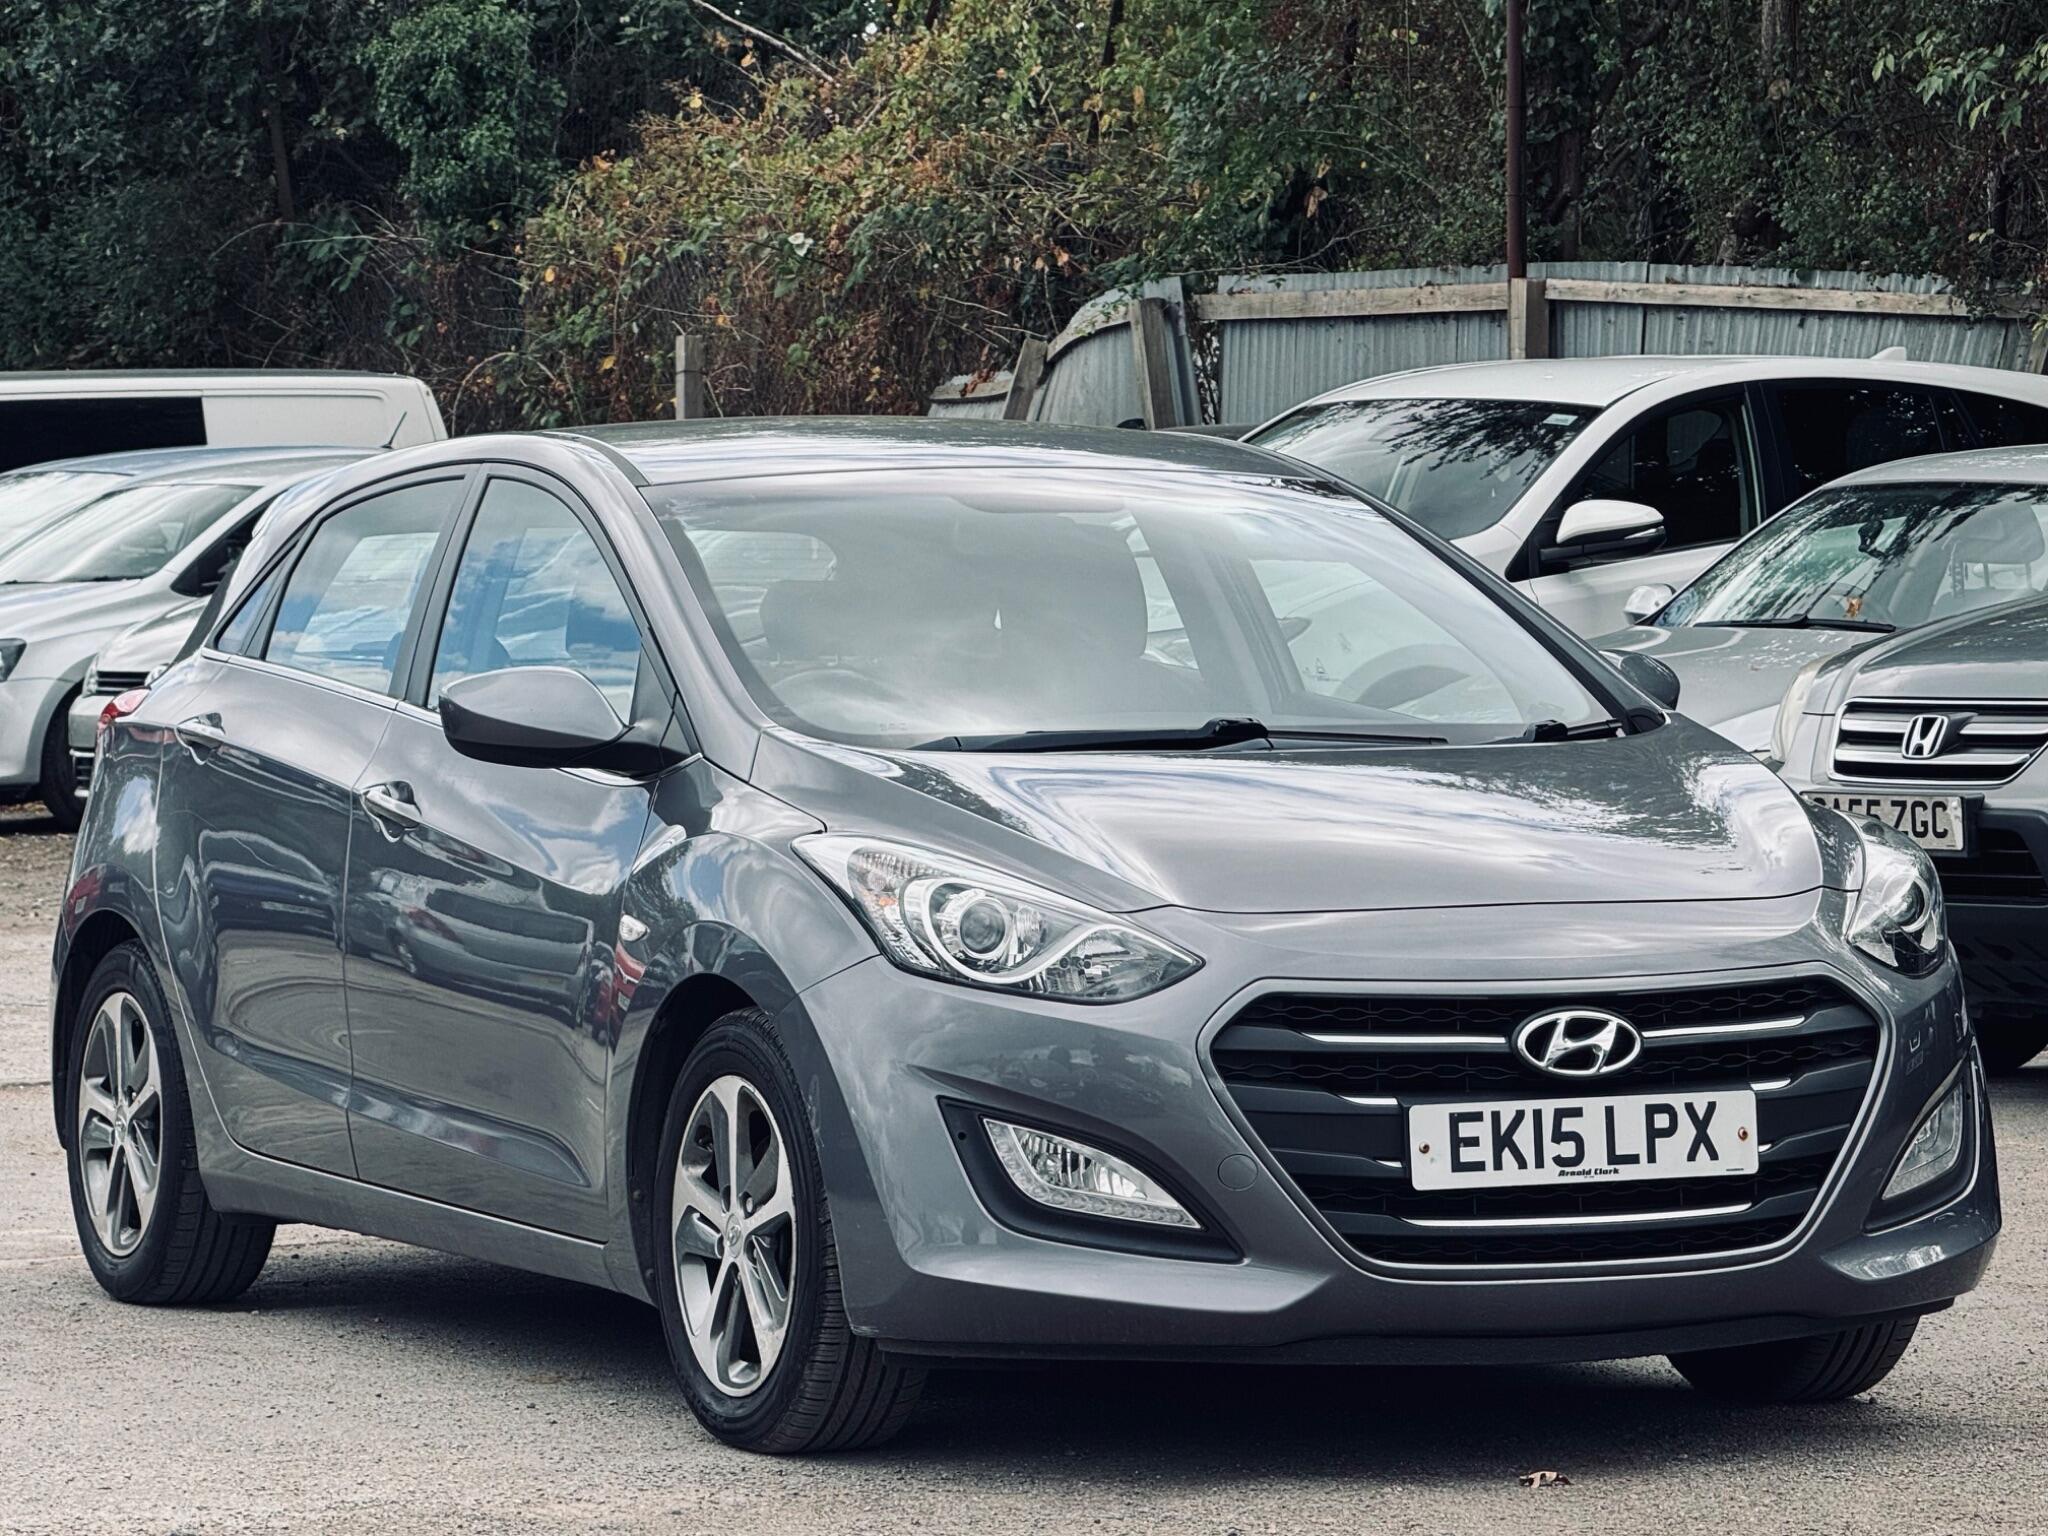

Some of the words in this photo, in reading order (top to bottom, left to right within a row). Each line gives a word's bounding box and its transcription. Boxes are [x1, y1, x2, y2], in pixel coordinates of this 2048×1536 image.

[1890, 800, 1949, 838] ZGC
[1449, 1106, 1586, 1173] EK15
[1605, 1100, 1720, 1166] LPX
[1558, 1169, 1592, 1177] Arnold
